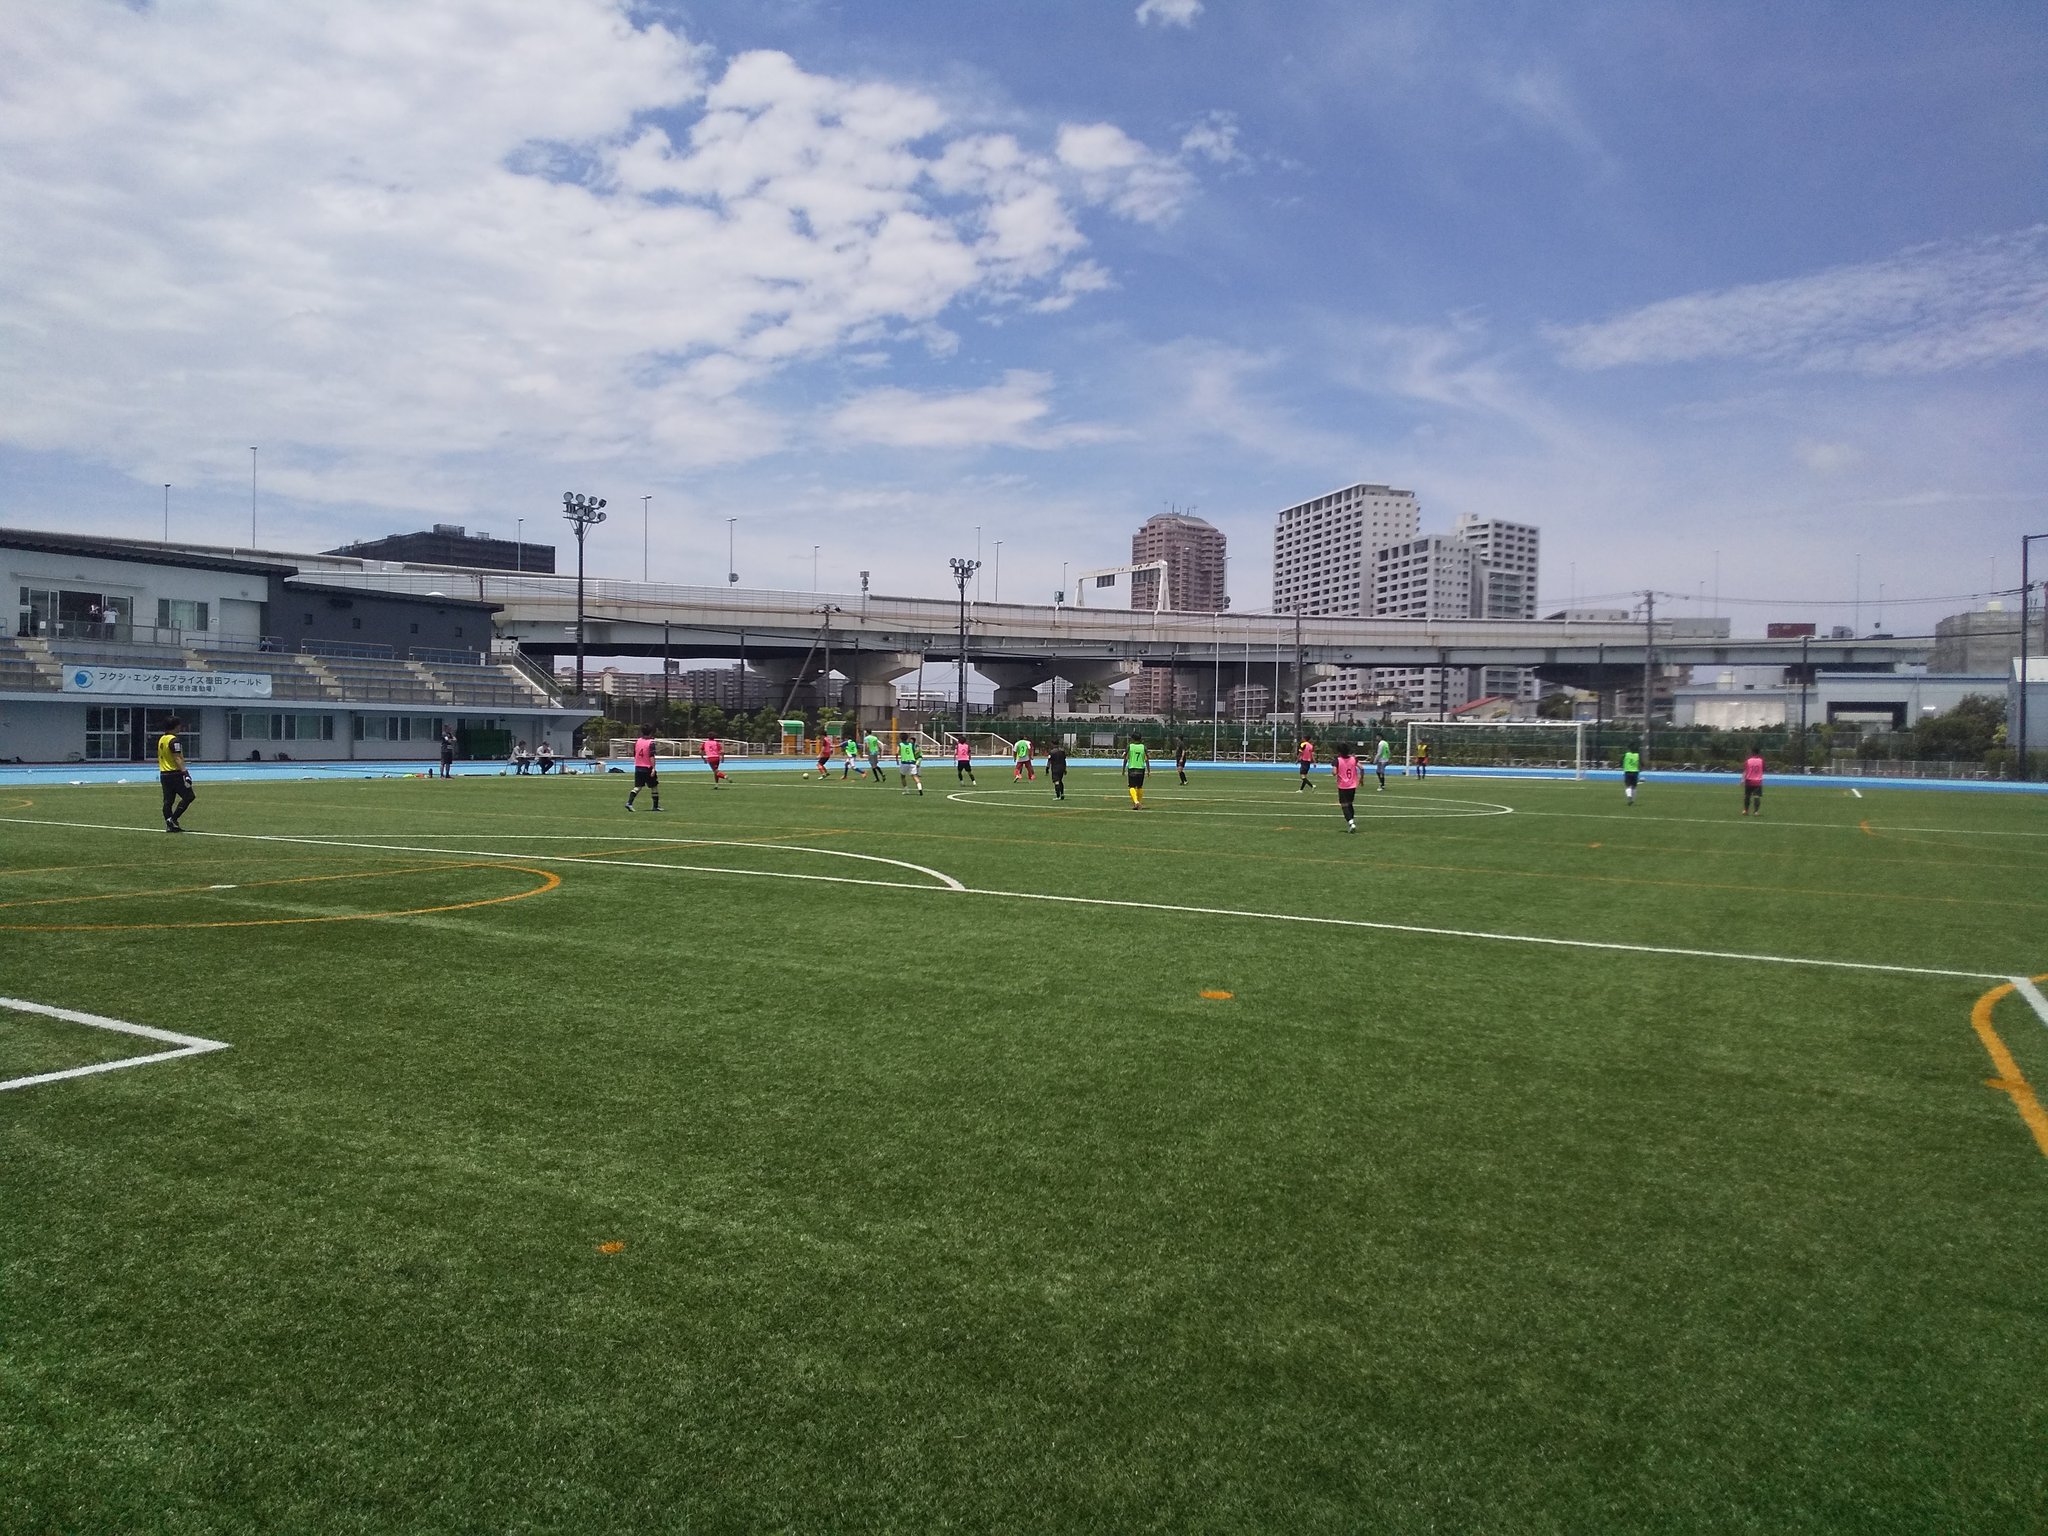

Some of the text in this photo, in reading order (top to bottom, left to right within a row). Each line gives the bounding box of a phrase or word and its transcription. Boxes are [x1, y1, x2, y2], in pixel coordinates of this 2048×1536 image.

[638, 748, 644, 758] 4
[1135, 752, 1141, 762] 7
[1346, 769, 1352, 780] 6
